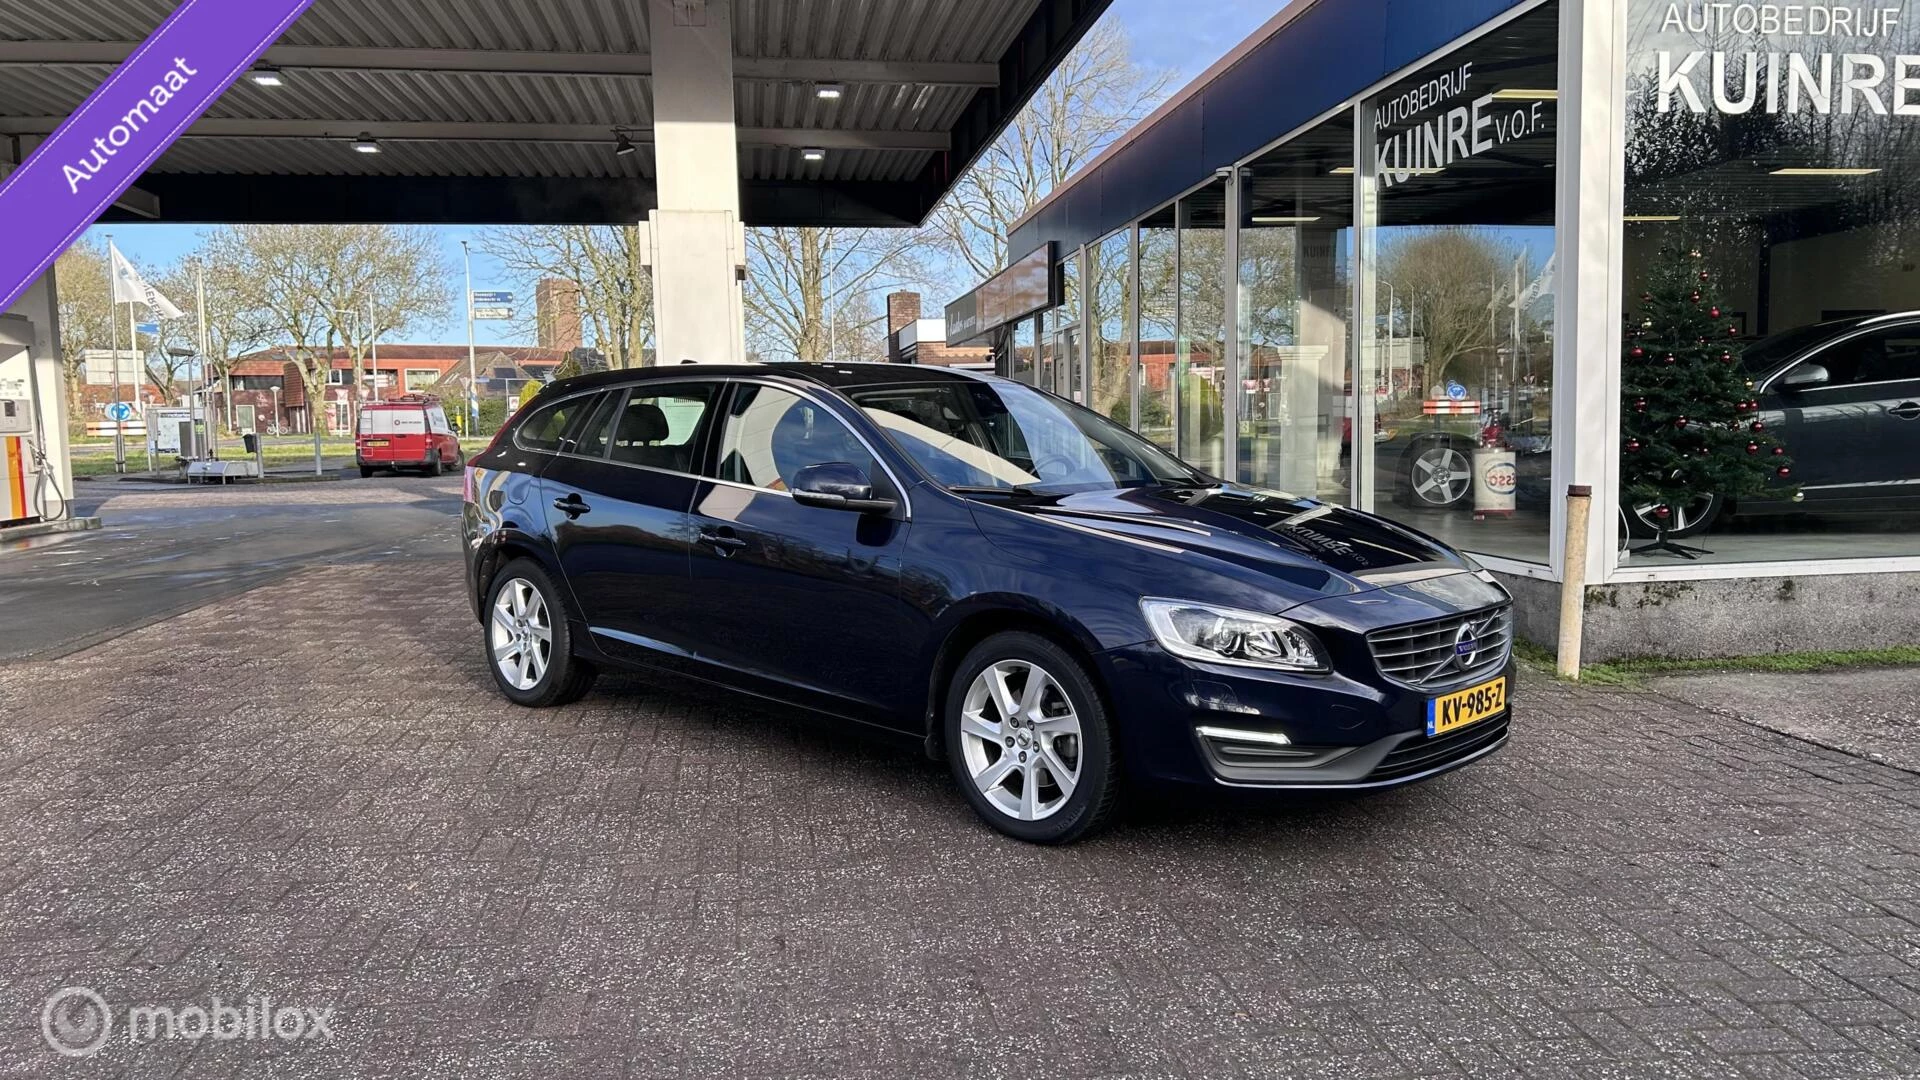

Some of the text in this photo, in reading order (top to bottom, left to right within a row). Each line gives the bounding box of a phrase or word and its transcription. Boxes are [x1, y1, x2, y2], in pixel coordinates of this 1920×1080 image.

[1661, 2, 1901, 38] AUTOBEDRIJF
[1374, 61, 1473, 133] AUTOBEDRIJF
[1657, 51, 1920, 115] KUINRE
[1374, 92, 1545, 193] KUINRE V.O.F.
[1427, 682, 1503, 729] NL KV-985-Z
